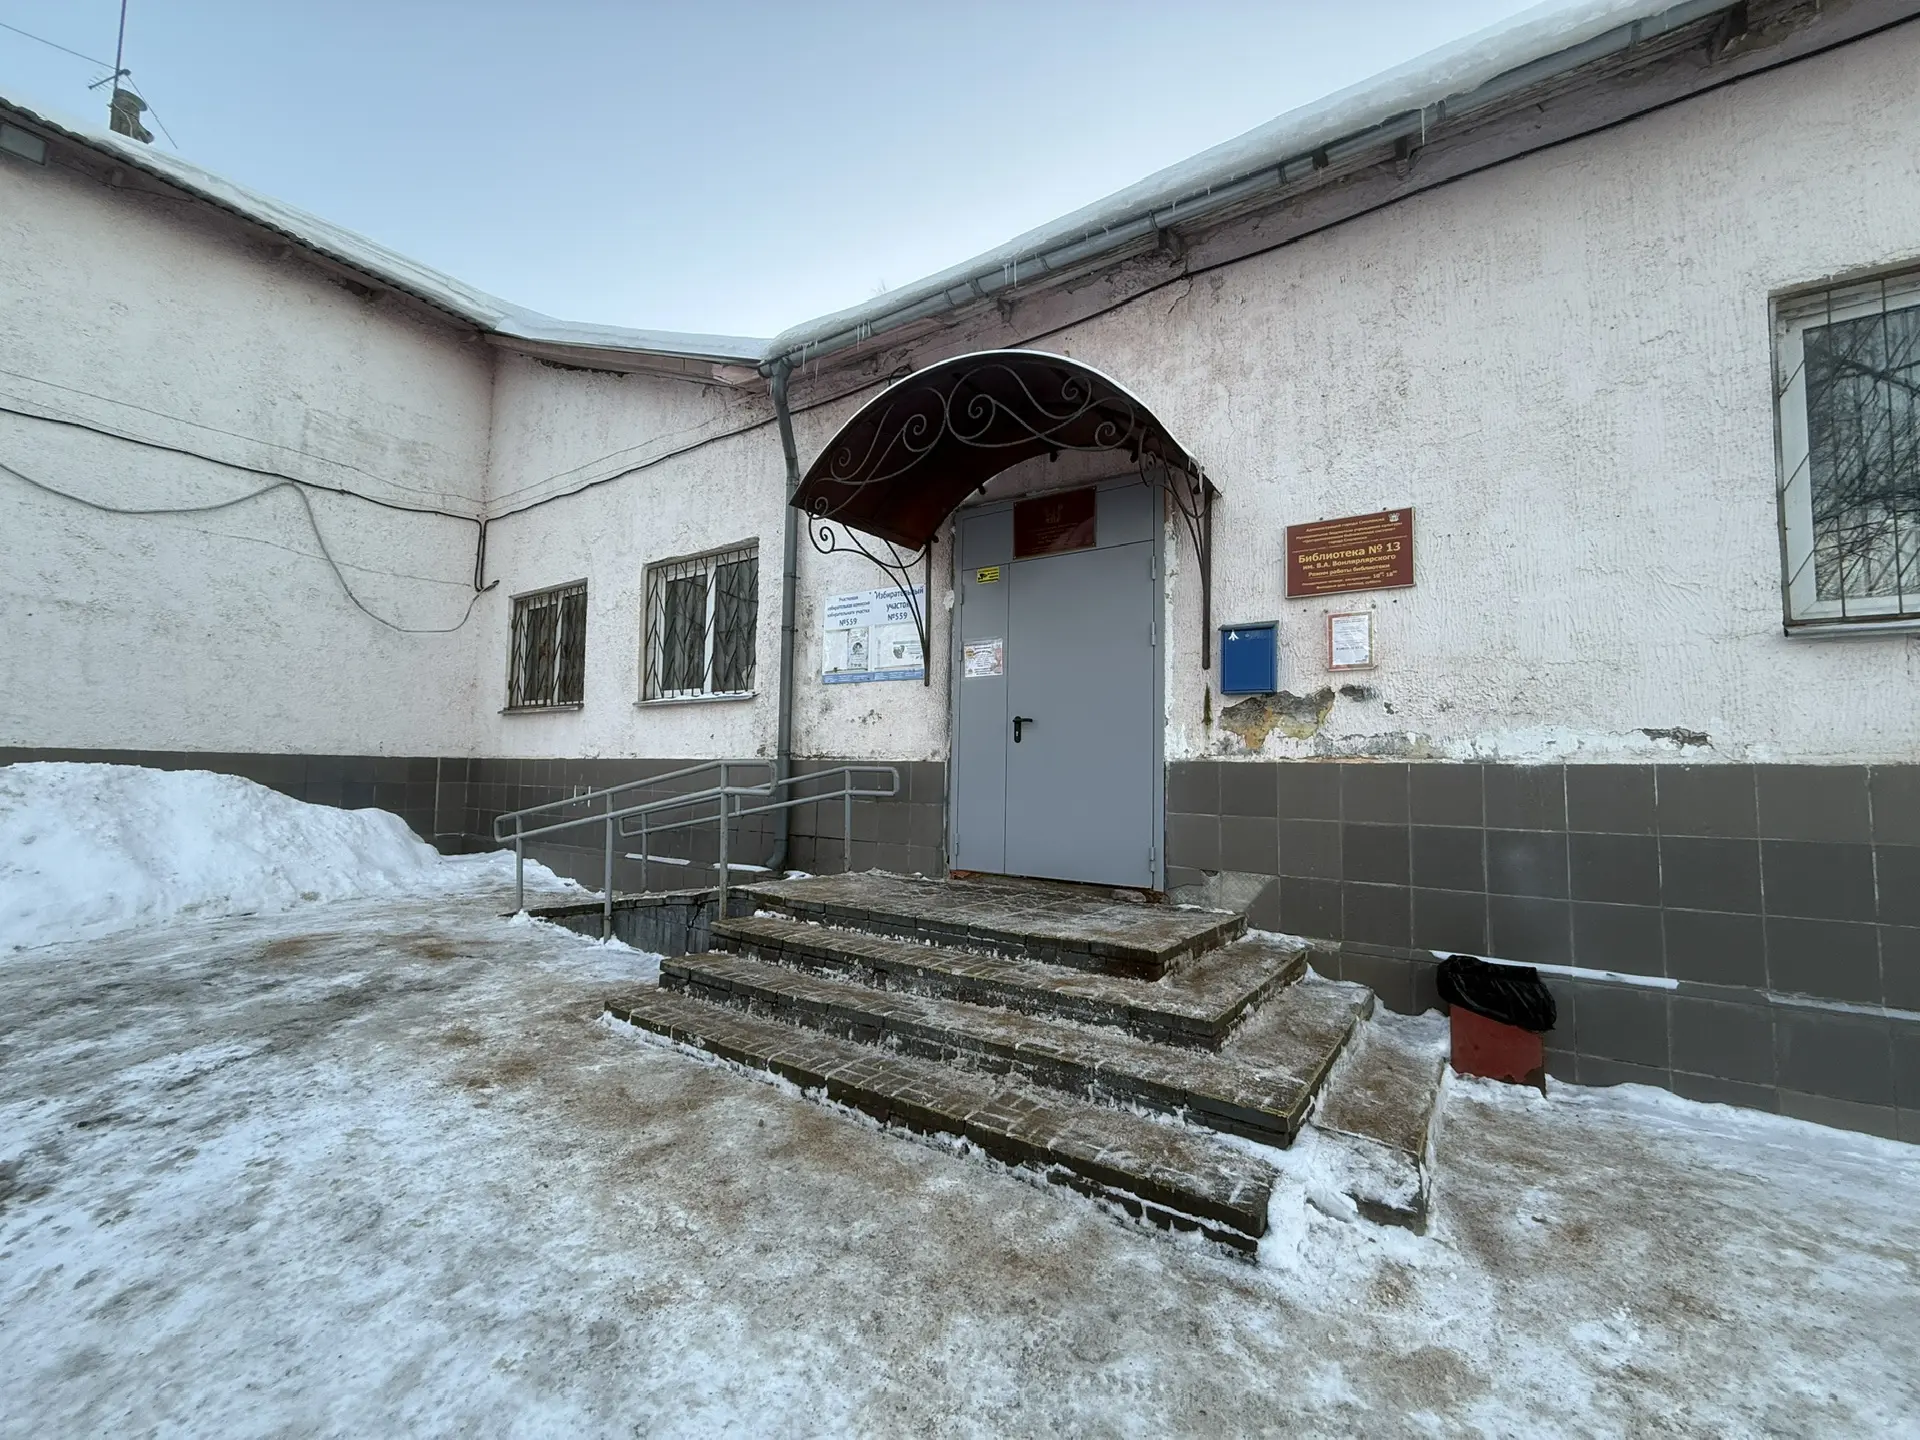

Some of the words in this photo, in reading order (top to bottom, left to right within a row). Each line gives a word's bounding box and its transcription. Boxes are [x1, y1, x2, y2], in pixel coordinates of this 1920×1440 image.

[1298, 548, 1365, 563] Библиотека
[1368, 544, 1383, 555] №
[1386, 541, 1401, 552] 13
[1332, 554, 1397, 567] Вонлярлярского
[1329, 567, 1352, 576] работы
[1352, 563, 1390, 573] библиотеки
[876, 586, 924, 600] Избиратеьый
[839, 617, 858, 627] №559
[887, 611, 908, 621] №559
